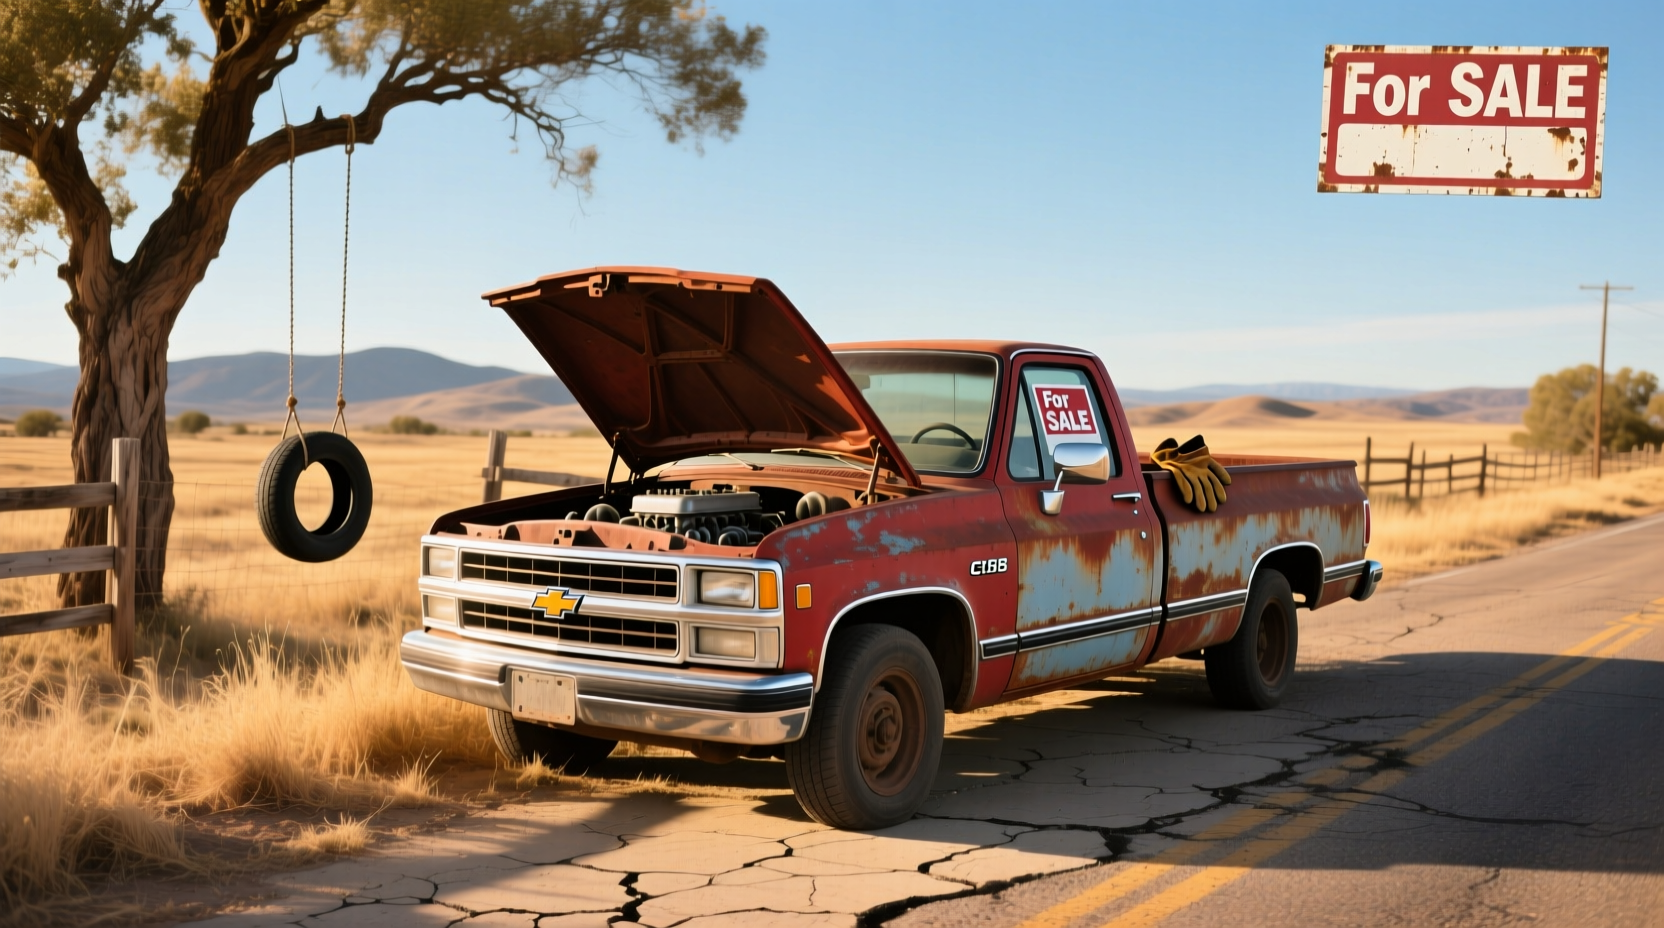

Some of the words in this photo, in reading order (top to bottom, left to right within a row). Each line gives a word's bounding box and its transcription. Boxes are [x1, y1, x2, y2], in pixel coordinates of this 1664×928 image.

[1343, 62, 1430, 116] For
[1448, 62, 1588, 119] SALE
[1042, 390, 1069, 408] For
[1046, 410, 1092, 431] SALE
